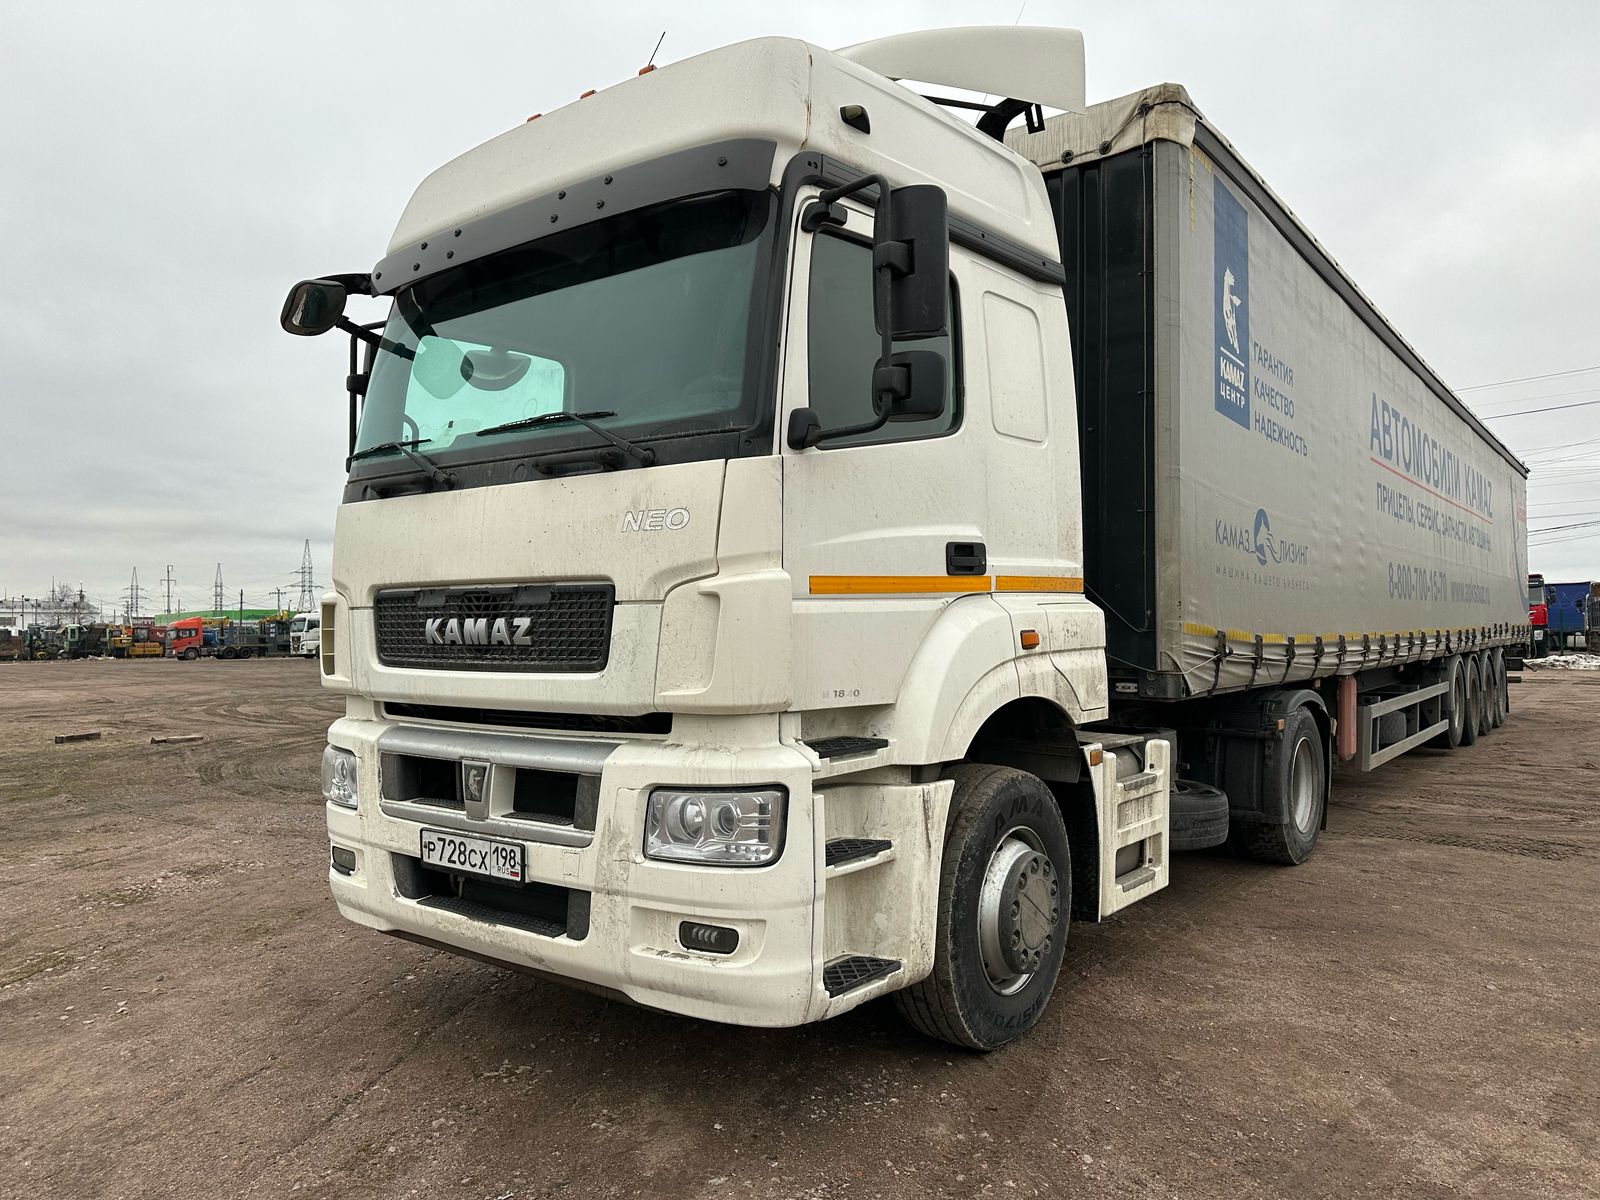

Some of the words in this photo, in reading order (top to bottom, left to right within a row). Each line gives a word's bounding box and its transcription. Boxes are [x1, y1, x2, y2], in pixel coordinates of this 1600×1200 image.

[1220, 356, 1245, 392] KAMAZ
[1253, 341, 1294, 388] ГАРАНТИЯ
[1220, 381, 1246, 409] ЦЕНТР
[1254, 375, 1295, 419] КАЧЕСТВО
[1254, 410, 1308, 457] НАДЕЖНОСТЬ
[1370, 391, 1461, 501] АВТОМОБИЛИ
[621, 507, 690, 532] NEO
[1215, 518, 1251, 553] КАМАЗ
[425, 617, 532, 646] KAMAZ
[492, 845, 517, 869] 198
[497, 866, 510, 875] RUS
